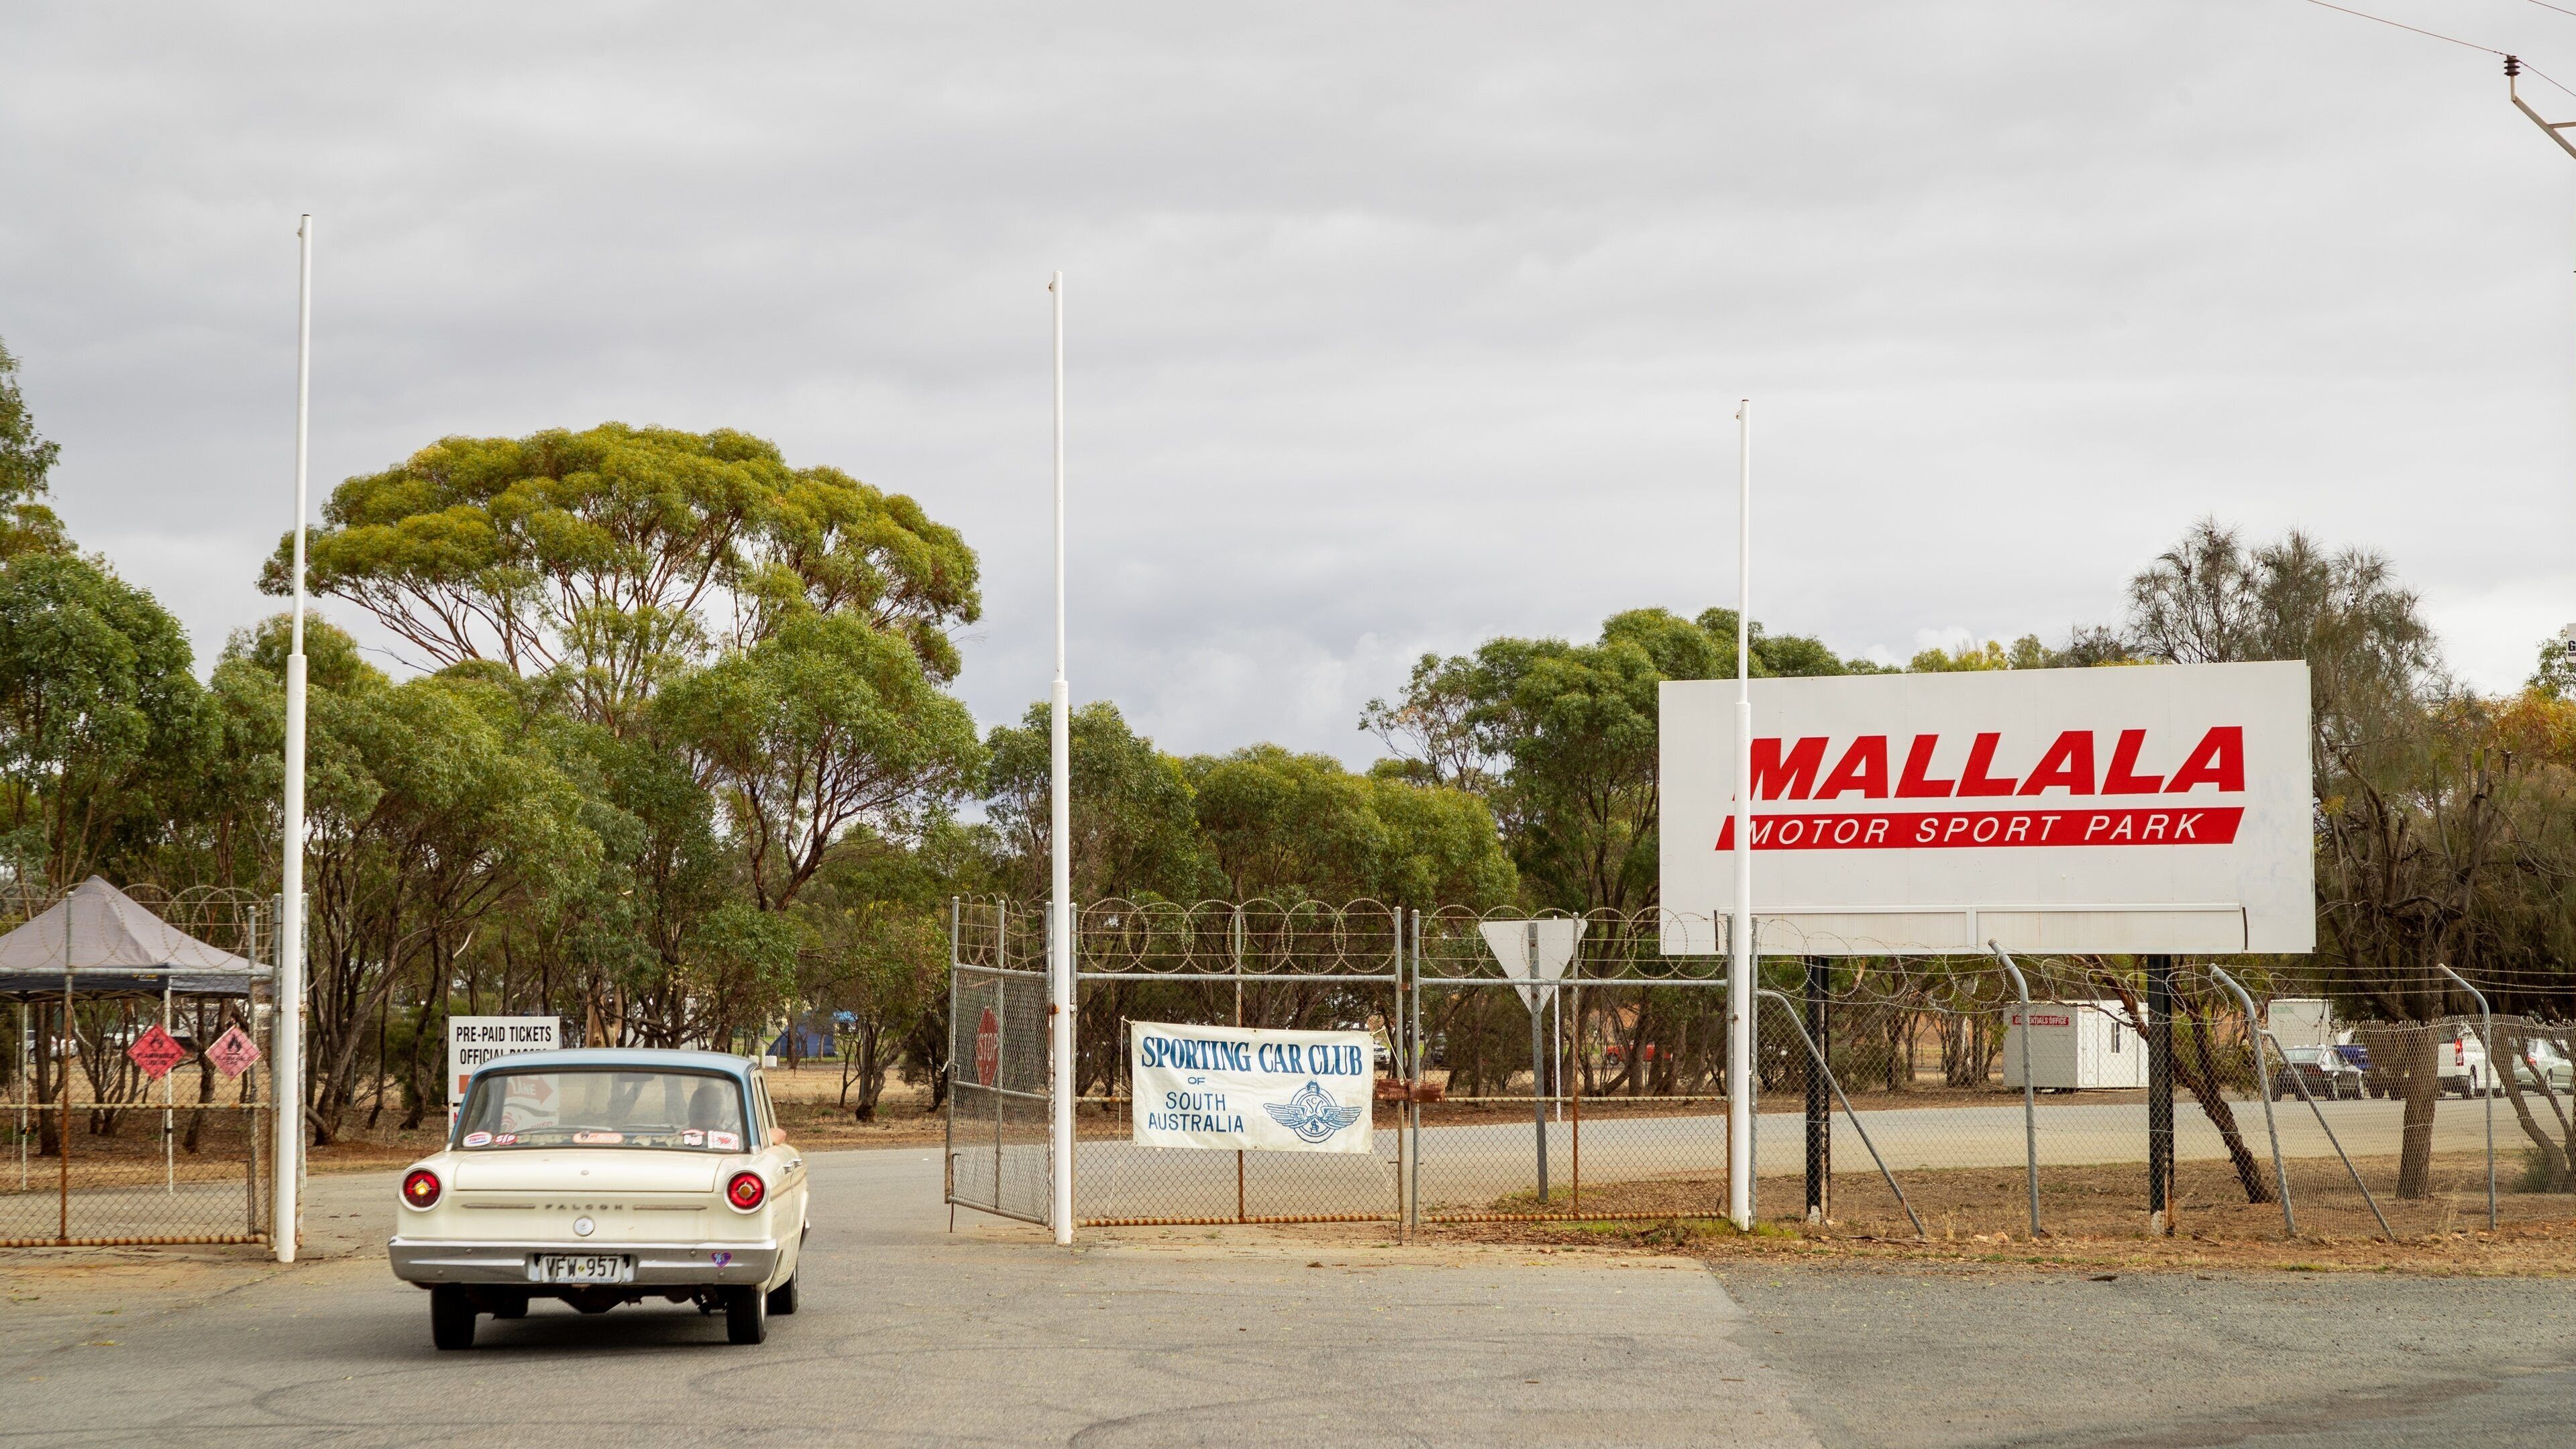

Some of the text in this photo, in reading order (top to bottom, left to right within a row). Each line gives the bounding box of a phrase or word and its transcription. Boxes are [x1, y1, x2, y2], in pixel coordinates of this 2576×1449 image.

[1733, 727, 2245, 800] MALLALA
[1750, 812, 2204, 845] MOTOR SPORT PARK
[2049, 1017, 2067, 1025] OFFICE
[456, 1026, 551, 1042] PRE-PAID TICKETS
[1141, 1036, 1363, 1076] SPORTING CAR CLUB
[1187, 1077, 1205, 1085] OF
[1165, 1091, 1226, 1112] SOUTH
[1148, 1112, 1244, 1133] AUSTRALIA
[546, 1258, 618, 1277] VFW 957
